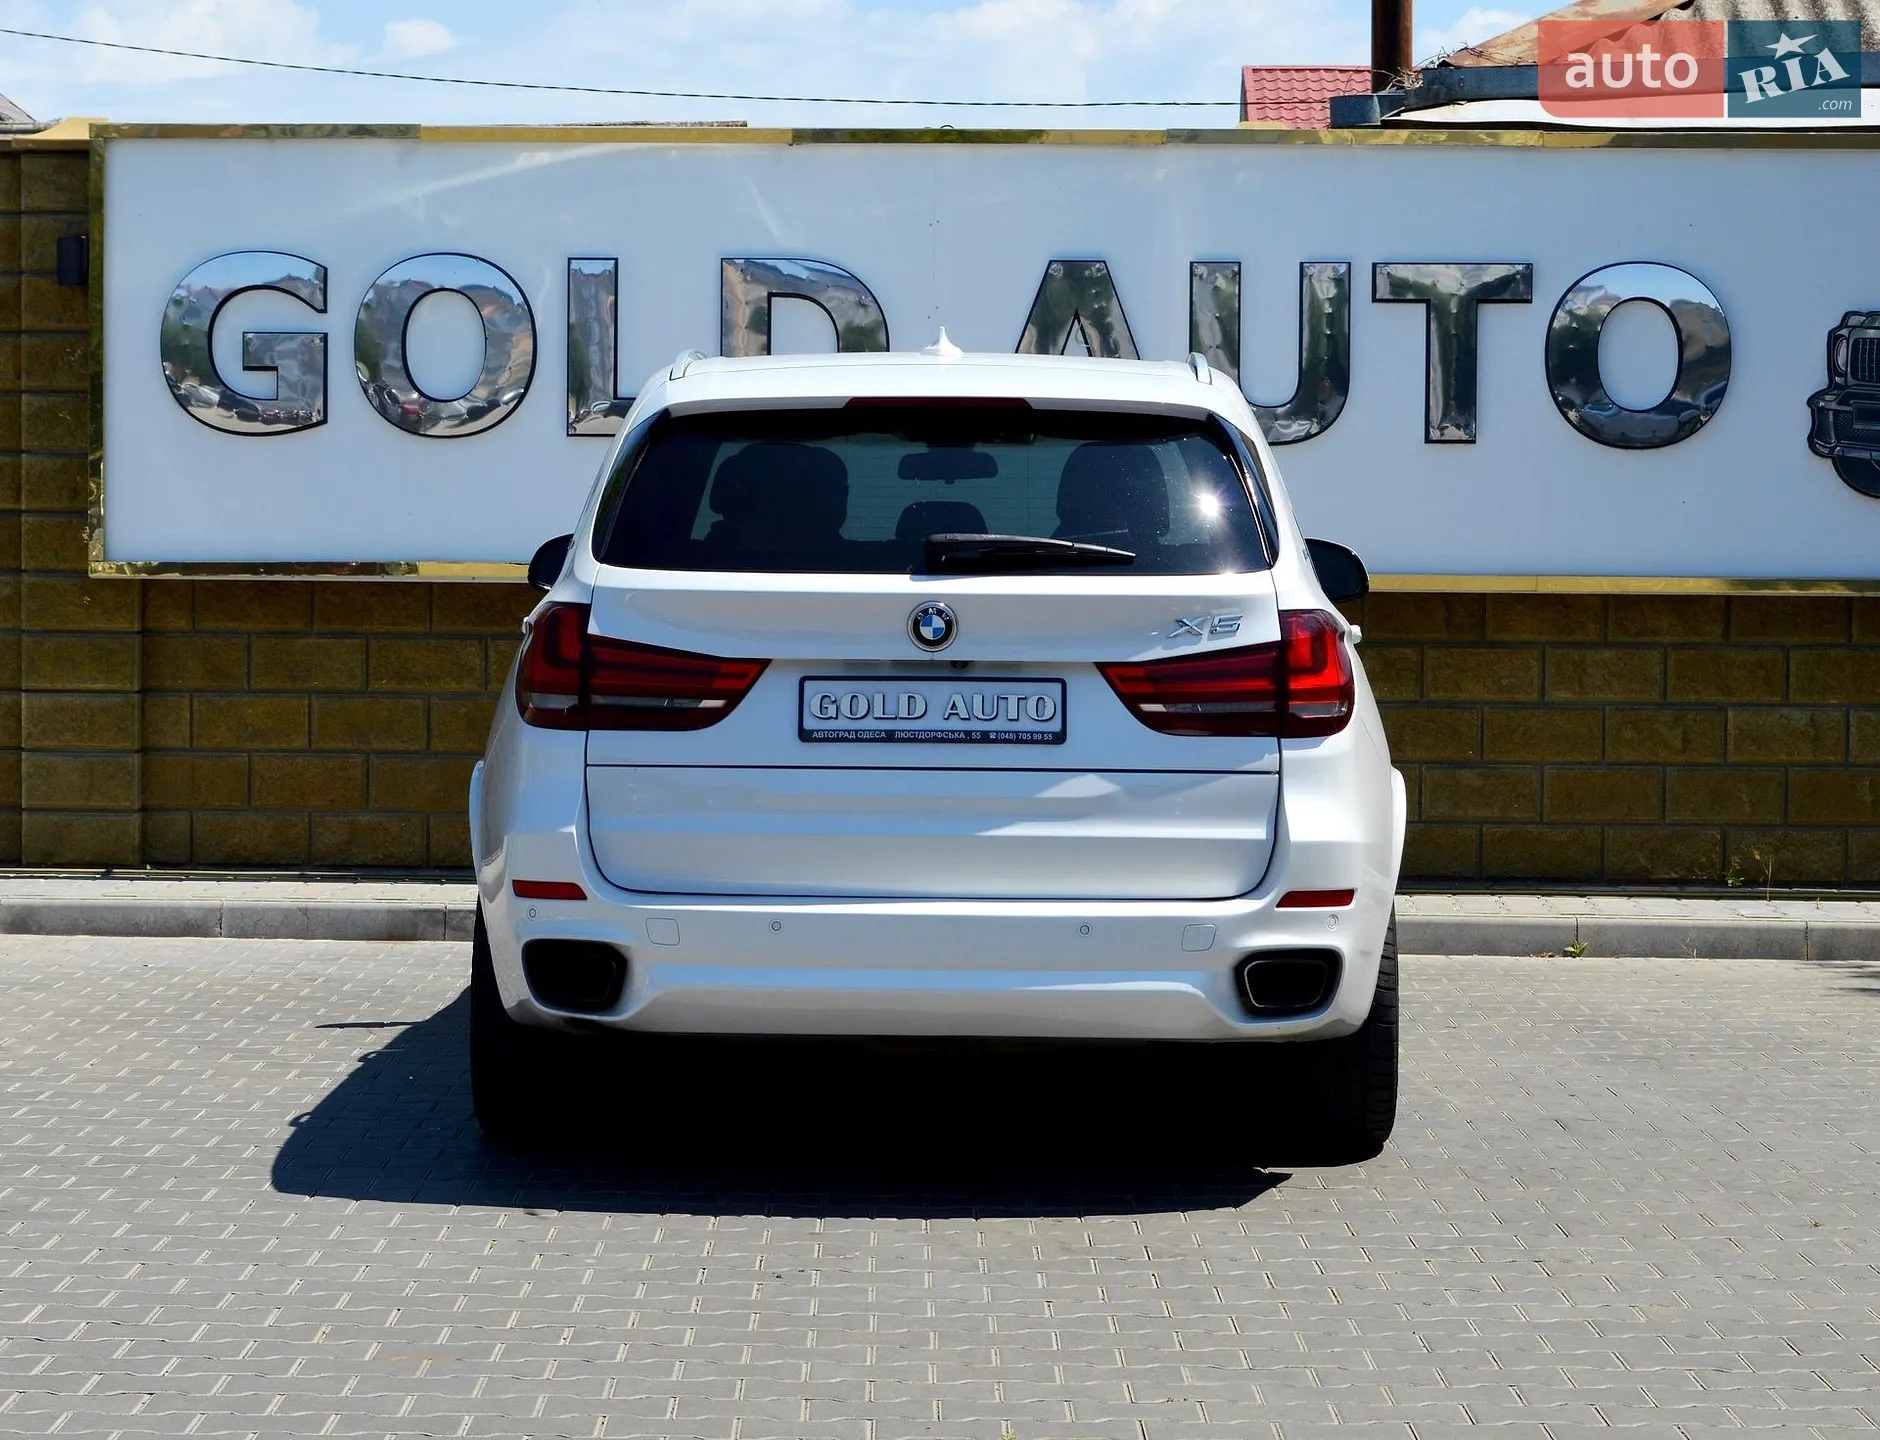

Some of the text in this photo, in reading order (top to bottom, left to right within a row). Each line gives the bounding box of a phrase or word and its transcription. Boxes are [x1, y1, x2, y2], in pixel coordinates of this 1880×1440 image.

[916, 606, 951, 621] BMW
[1166, 611, 1244, 638] X5
[809, 692, 1057, 722] GOLD AUTO
